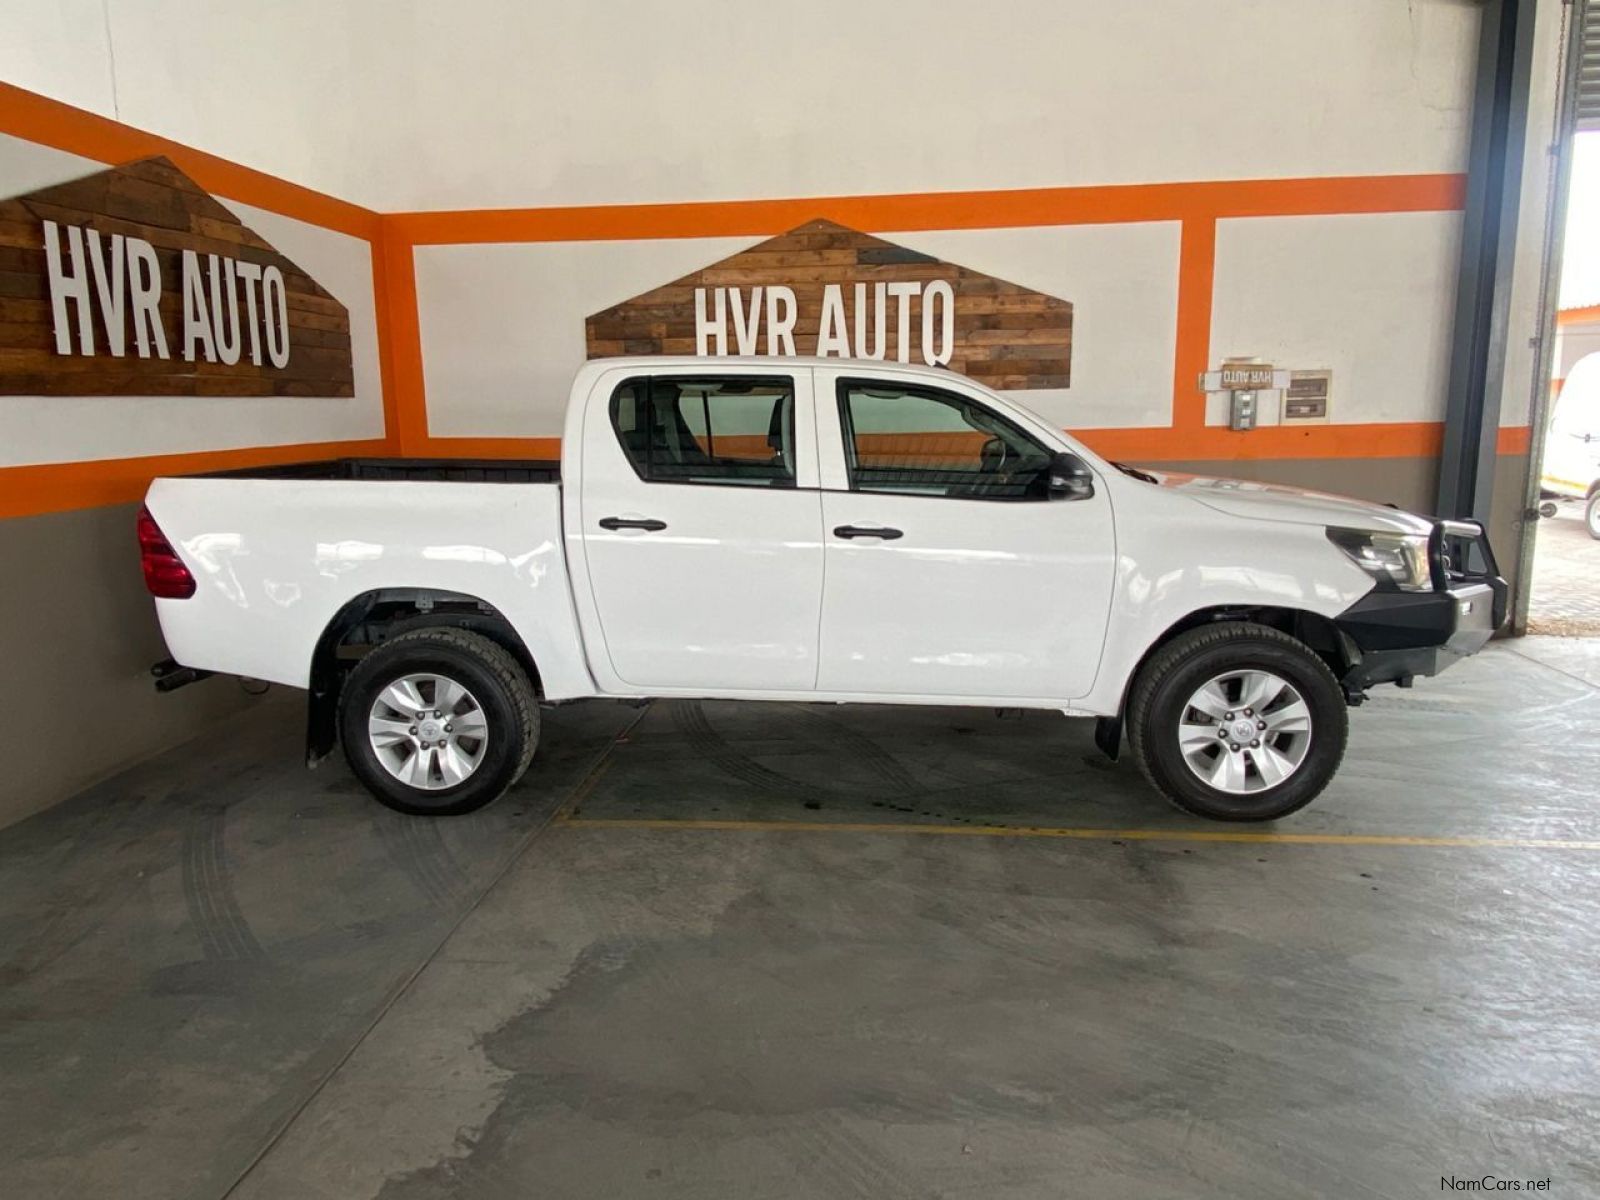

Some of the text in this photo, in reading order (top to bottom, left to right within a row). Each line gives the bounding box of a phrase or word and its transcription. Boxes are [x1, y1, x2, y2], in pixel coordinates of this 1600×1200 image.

[43, 219, 290, 370] HVR AUTO
[695, 279, 955, 367] HVR AUTO
[1223, 370, 1272, 384] HVR AUTO
